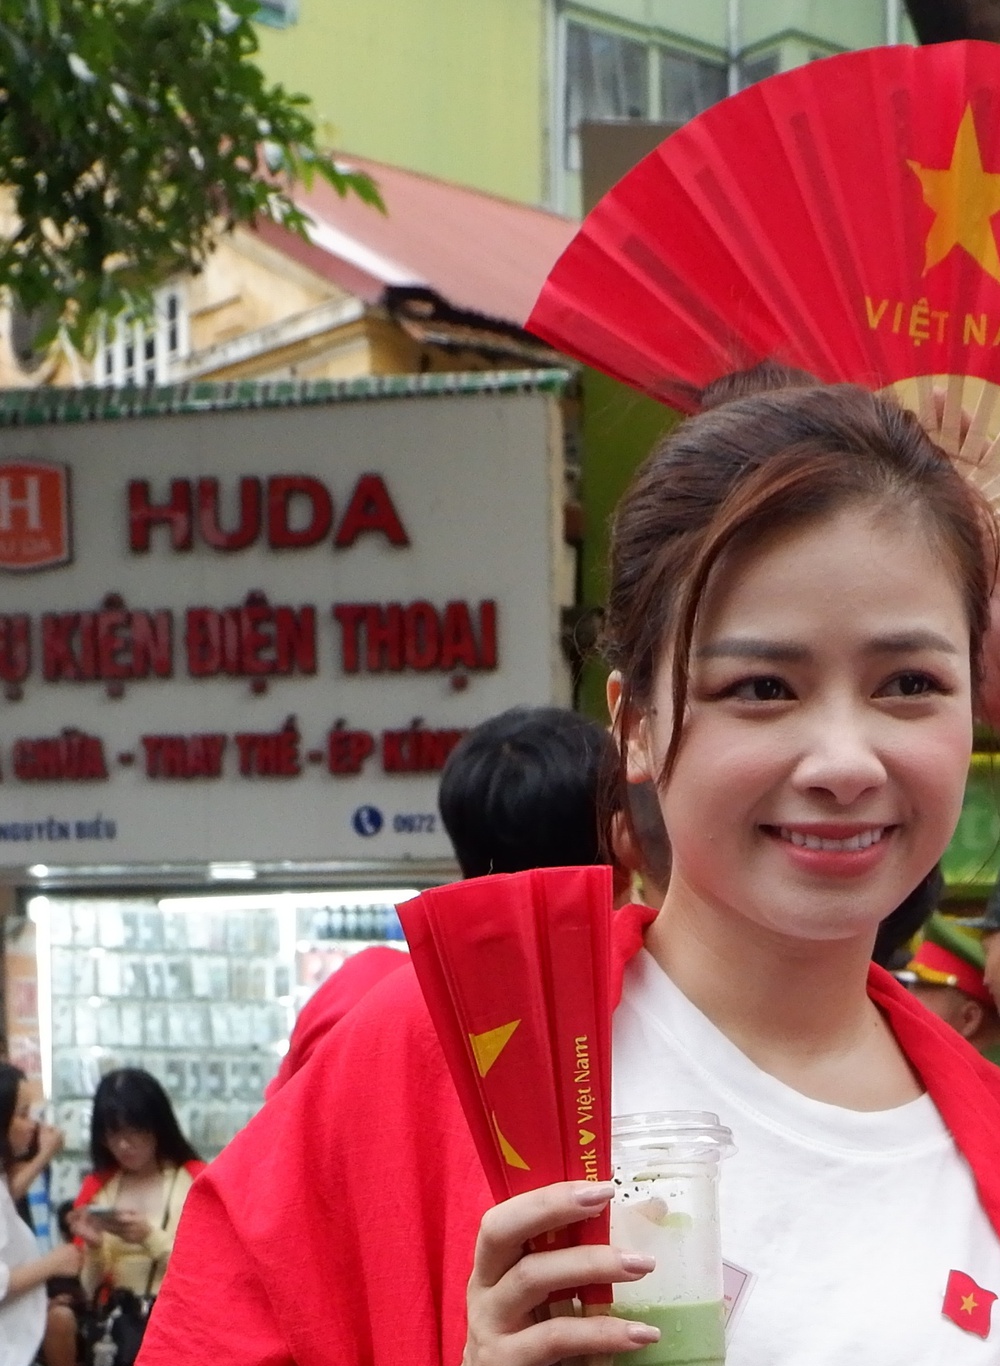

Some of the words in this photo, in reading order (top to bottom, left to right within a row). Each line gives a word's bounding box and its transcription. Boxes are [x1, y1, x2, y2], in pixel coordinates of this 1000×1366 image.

[865, 296, 949, 347] VIỆT
[128, 472, 410, 555] HUDA
[42, 592, 174, 699] KIỆN
[186, 589, 318, 697] ĐIỆN
[332, 598, 497, 693] THOẠI
[140, 732, 228, 781] THAY
[234, 713, 301, 779] THẾ
[573, 1034, 591, 1083] Nam
[577, 1087, 596, 1124] Việt
[581, 1149, 598, 1182] ank
